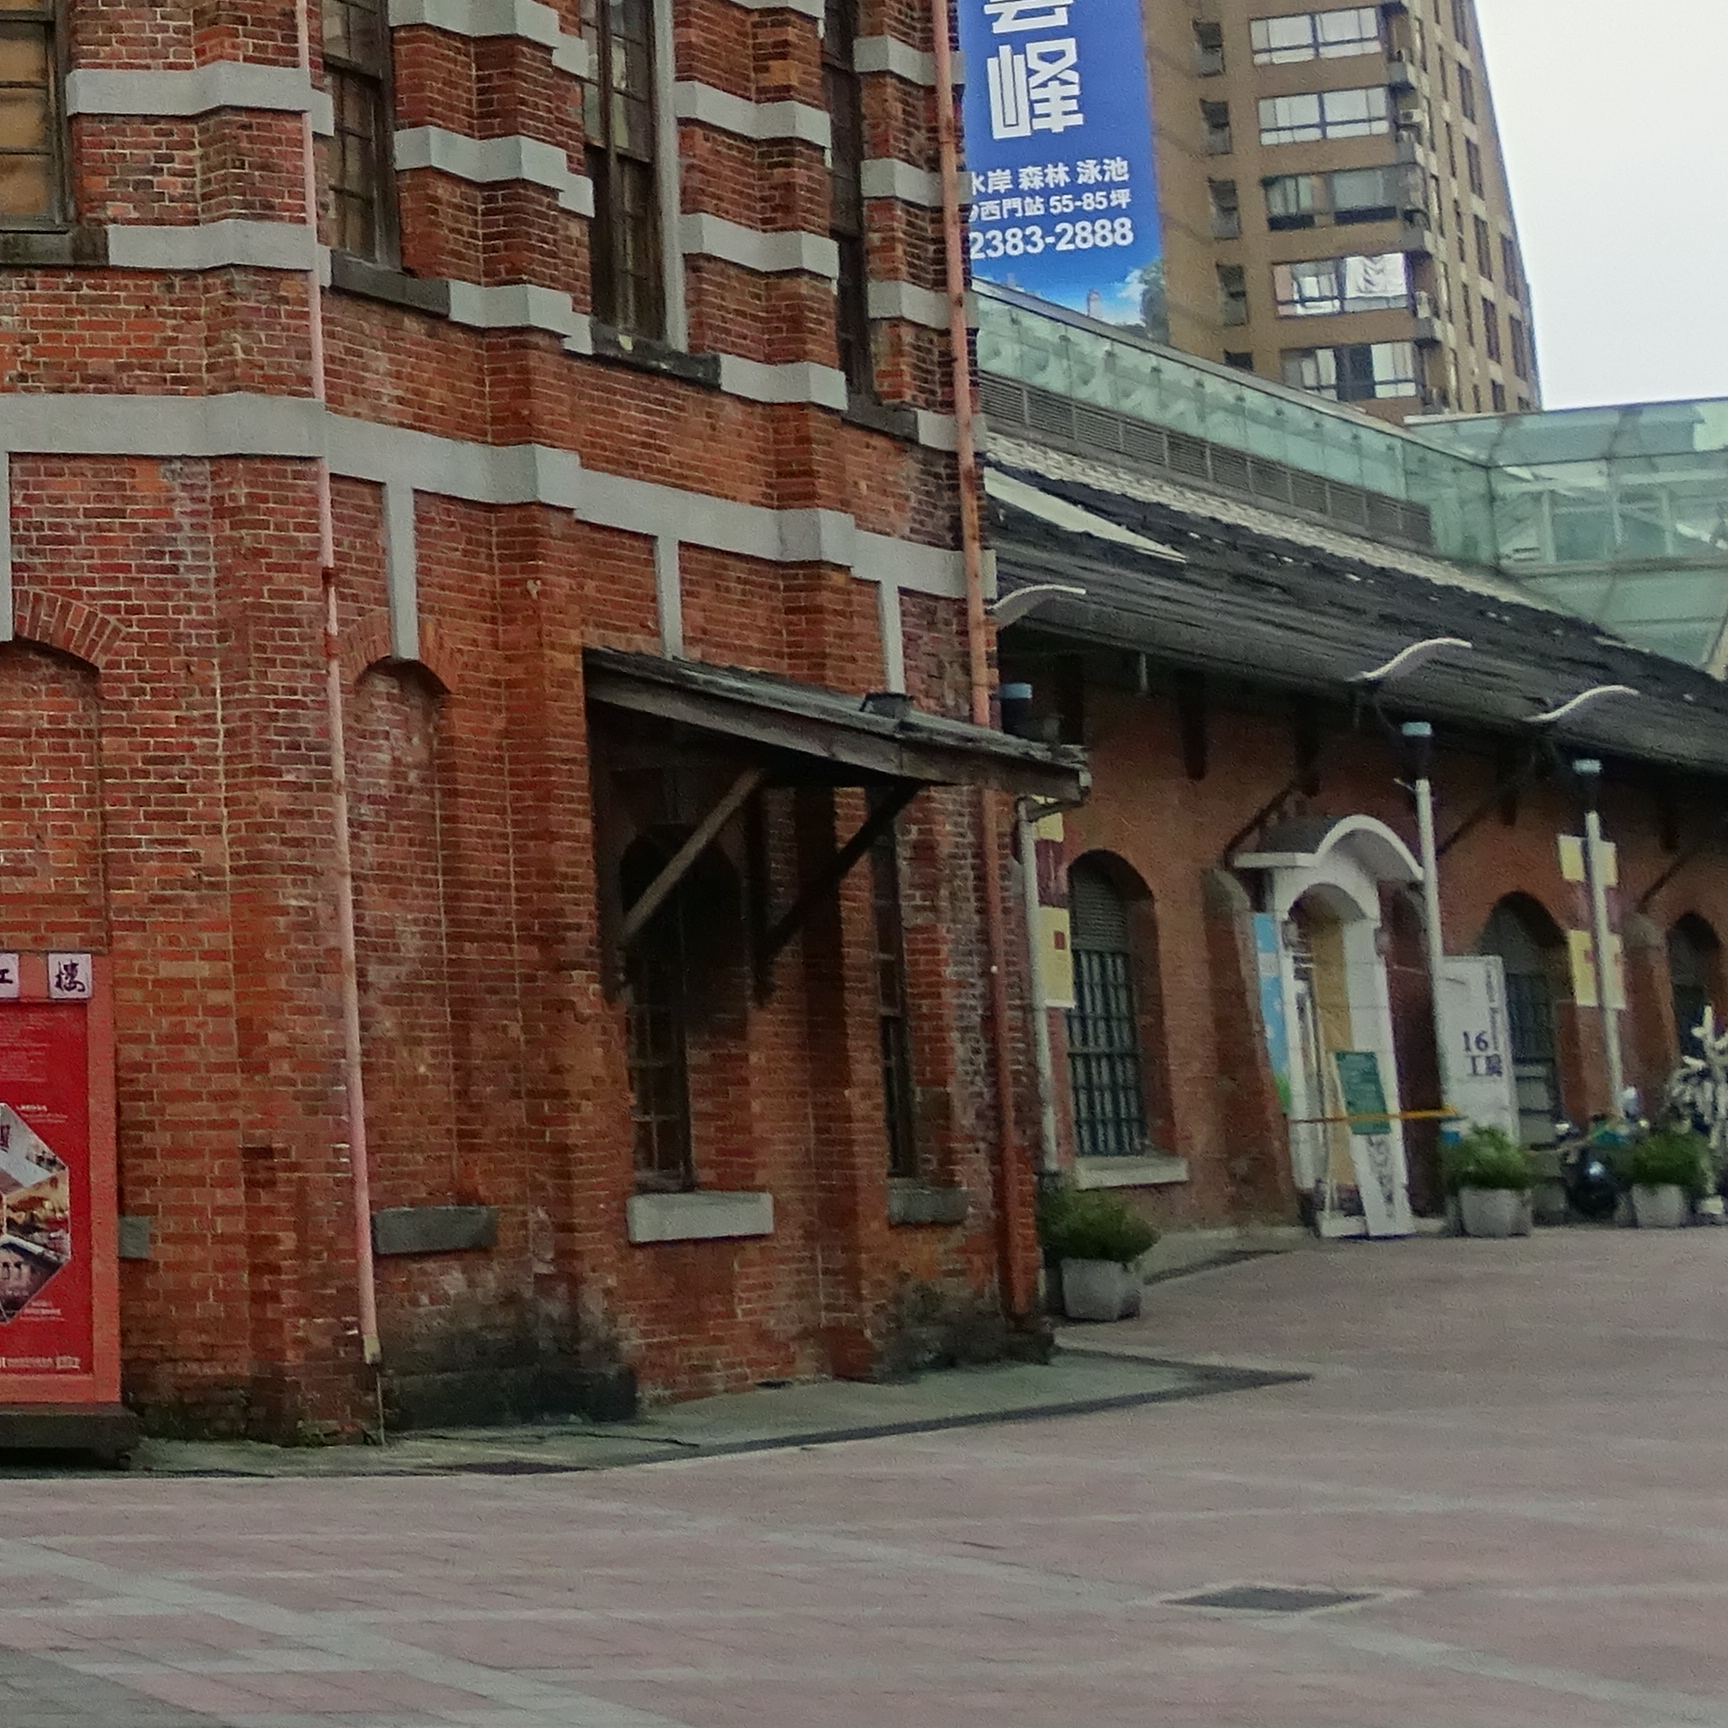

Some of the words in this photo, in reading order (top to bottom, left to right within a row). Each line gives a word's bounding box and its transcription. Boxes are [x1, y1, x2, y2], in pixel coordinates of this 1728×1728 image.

[1018, 162, 1071, 191] 森林
[1076, 156, 1130, 184] 泳池
[969, 217, 1134, 260] 2383-2888
[1462, 1030, 1489, 1052] 16
